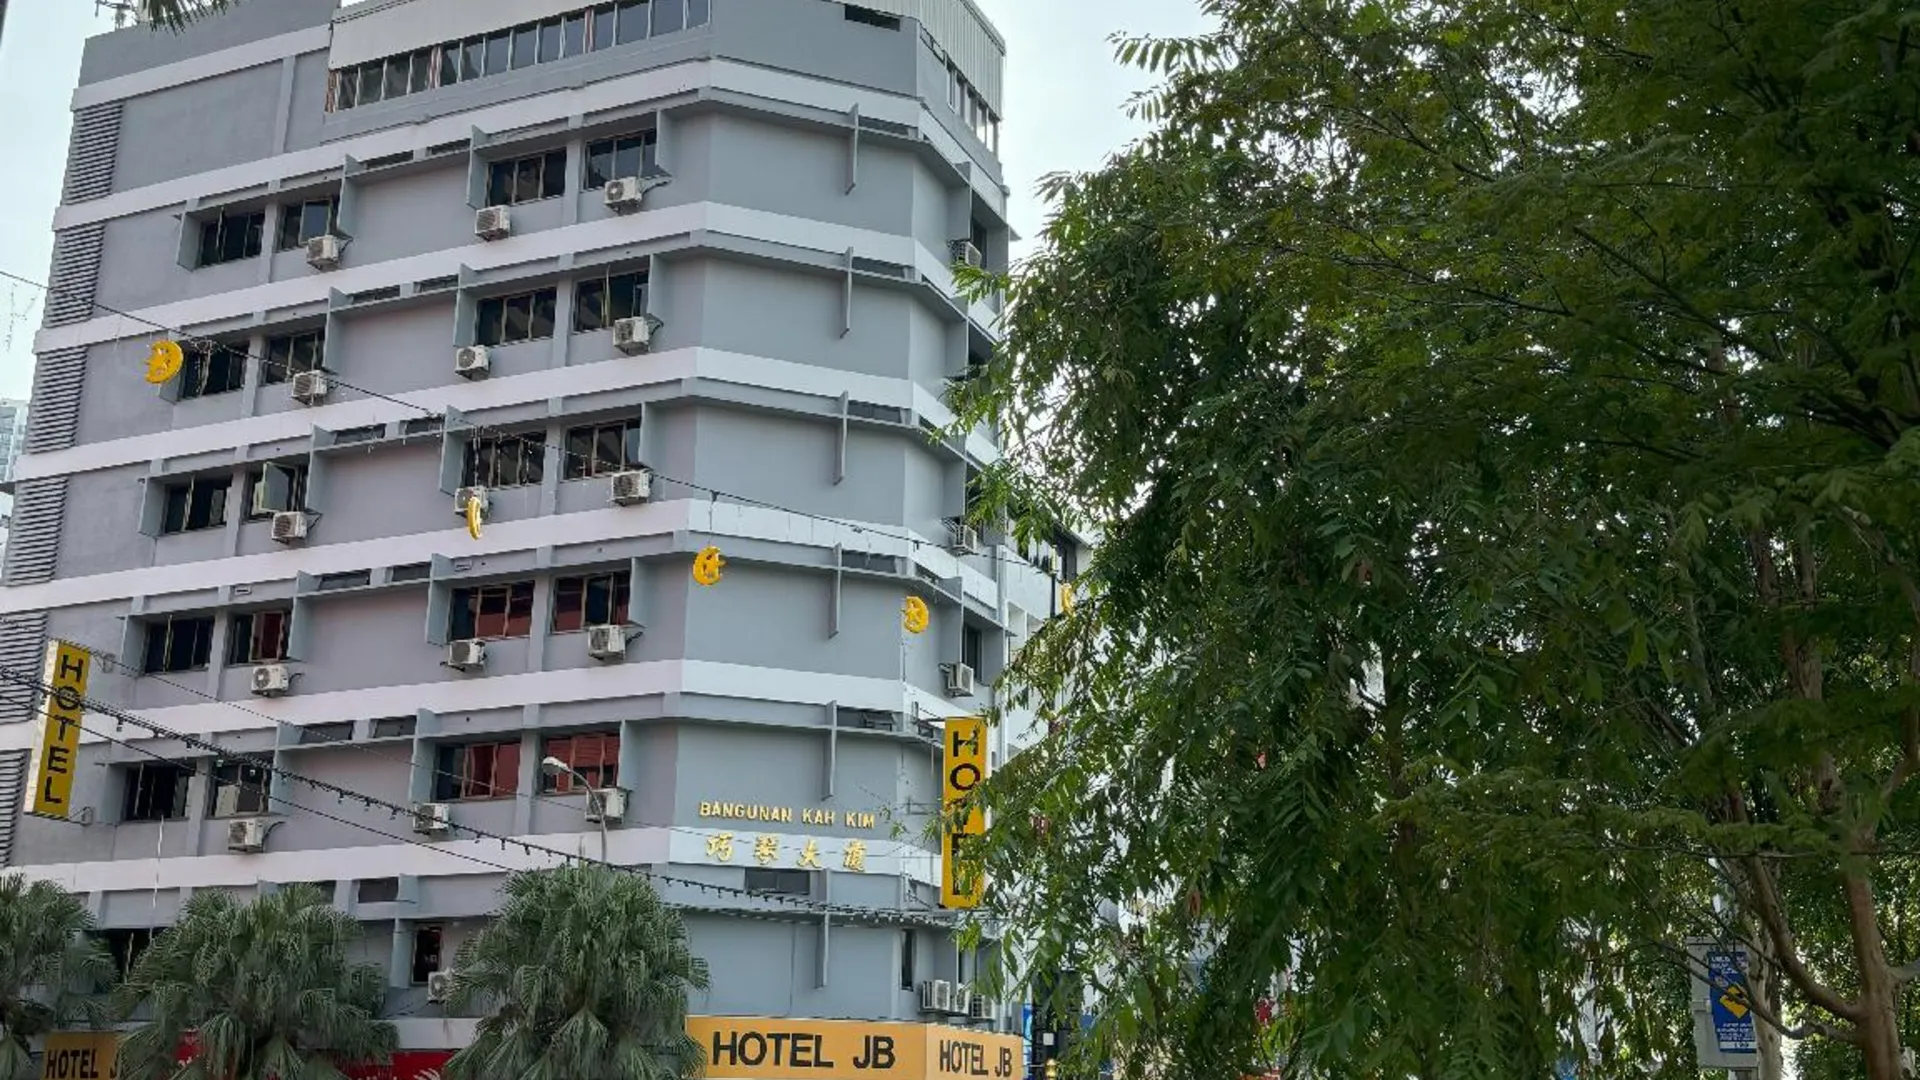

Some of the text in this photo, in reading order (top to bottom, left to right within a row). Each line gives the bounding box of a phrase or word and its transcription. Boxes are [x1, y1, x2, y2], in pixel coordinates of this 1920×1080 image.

[45, 653, 84, 804] HOTEL
[699, 800, 875, 829] BANGUNAN KAH KIM
[949, 730, 981, 896] HOE
[45, 1048, 99, 1079] HOTEL
[712, 1031, 896, 1069] HOTEL JB
[940, 1039, 989, 1076] HOTEL
[994, 1046, 1013, 1078] JB
